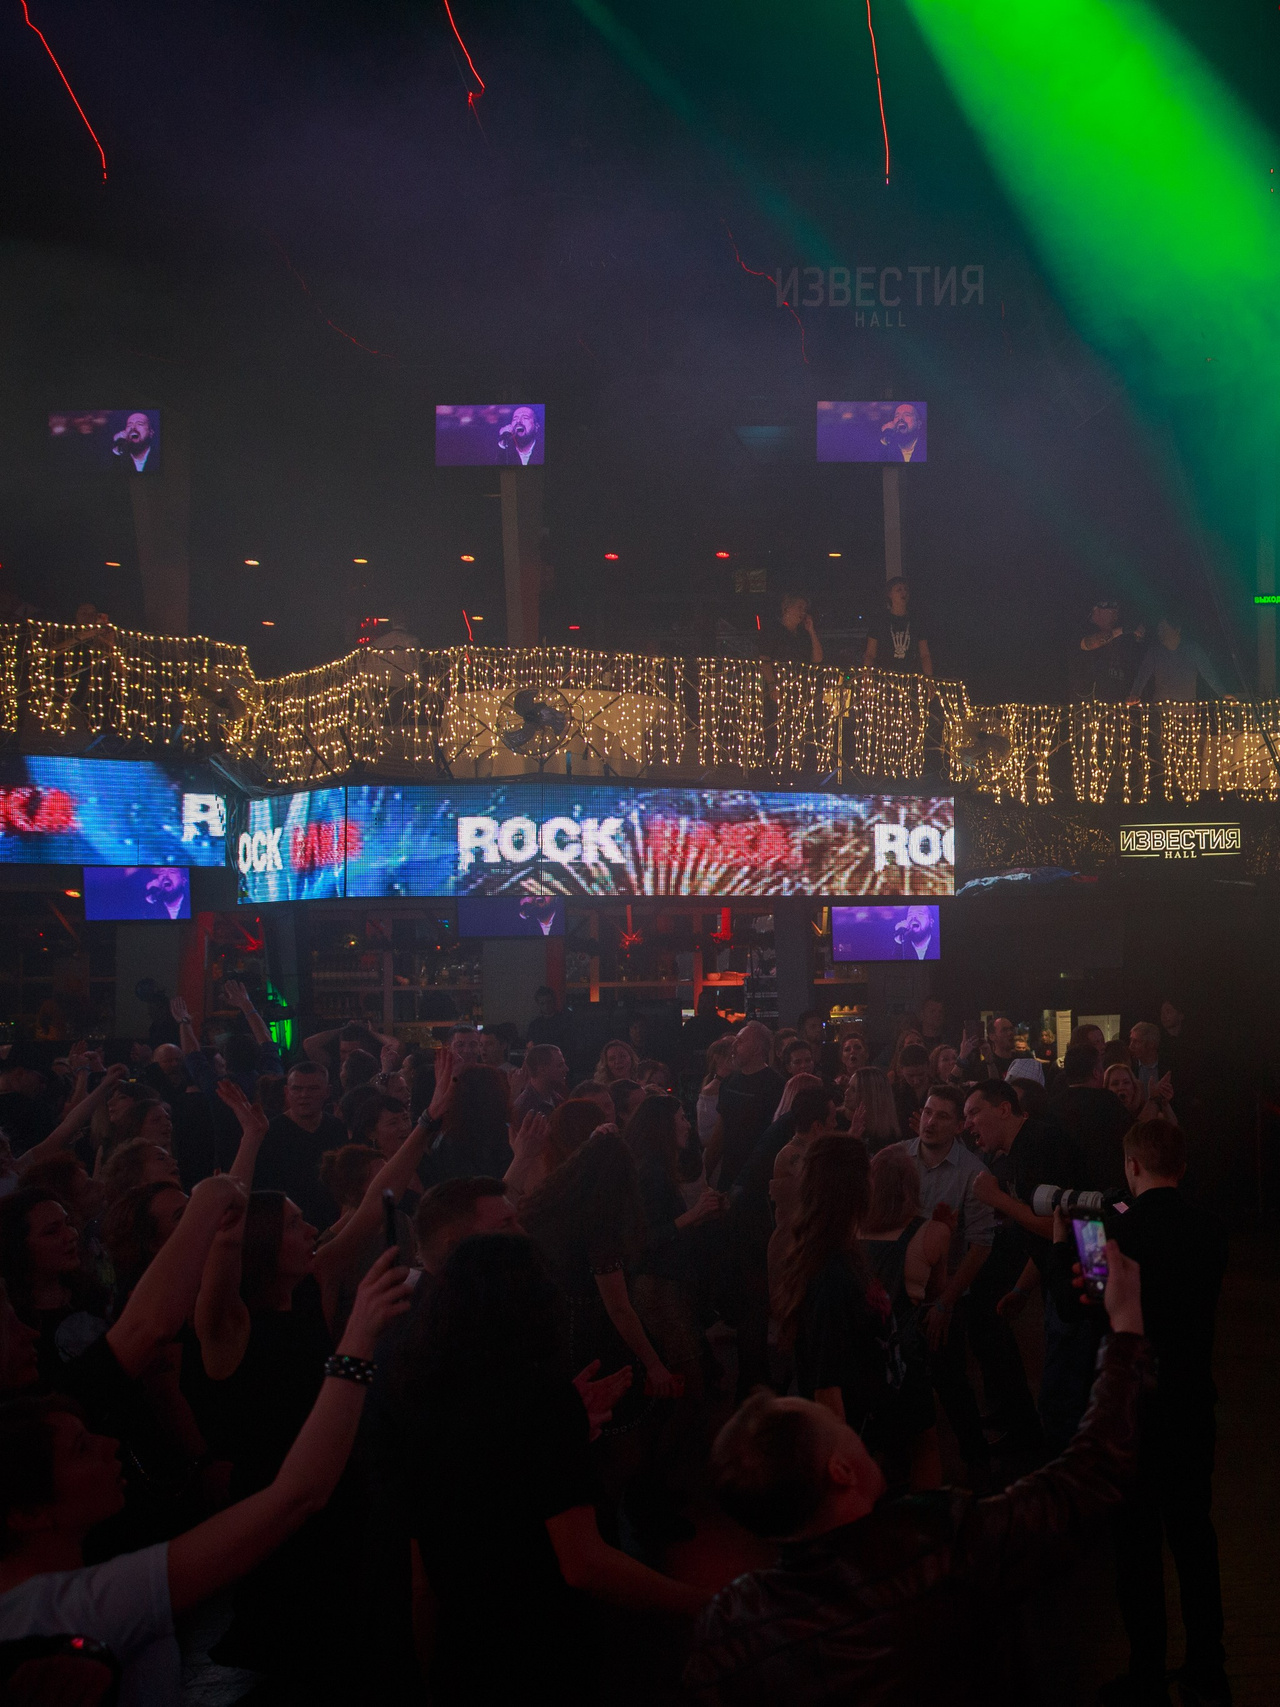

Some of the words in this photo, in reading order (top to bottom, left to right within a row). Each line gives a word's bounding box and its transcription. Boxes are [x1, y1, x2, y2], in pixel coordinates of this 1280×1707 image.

[776, 265, 984, 307] ИЗВЕСТИЯ
[855, 311, 907, 328] HALL
[457, 816, 627, 872] ROCK
[874, 823, 955, 872] RO
[1120, 828, 1241, 851] ИЗВЕСТИЯ
[1164, 850, 1198, 859] HALL
